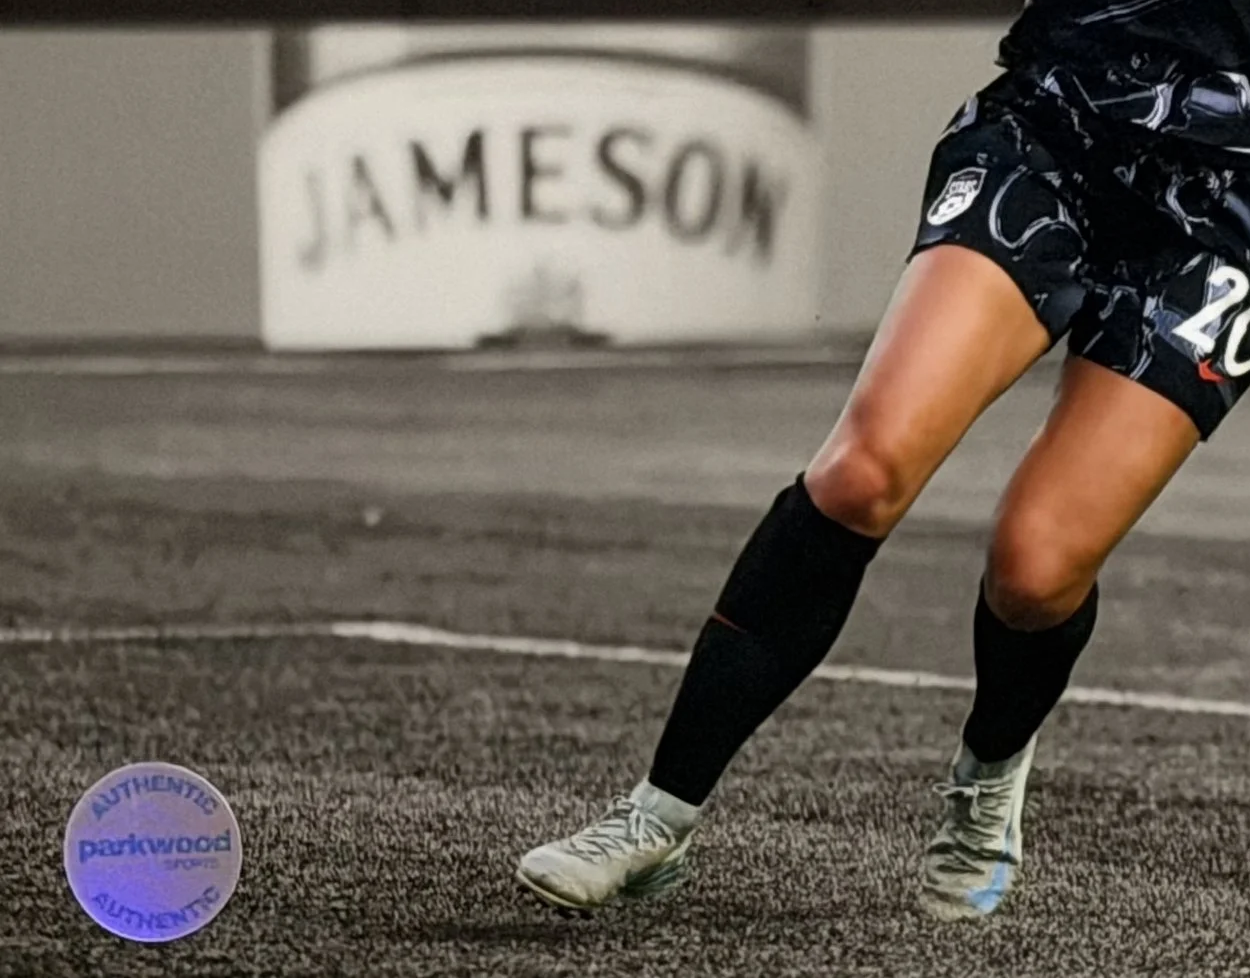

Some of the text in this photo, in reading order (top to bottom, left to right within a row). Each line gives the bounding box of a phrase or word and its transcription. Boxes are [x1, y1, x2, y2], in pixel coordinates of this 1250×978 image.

[298, 122, 790, 270] JAMESON
[91, 774, 218, 820] AUTHENTIC
[79, 828, 231, 864] parkwood
[91, 885, 221, 930] AUTHENTIC
